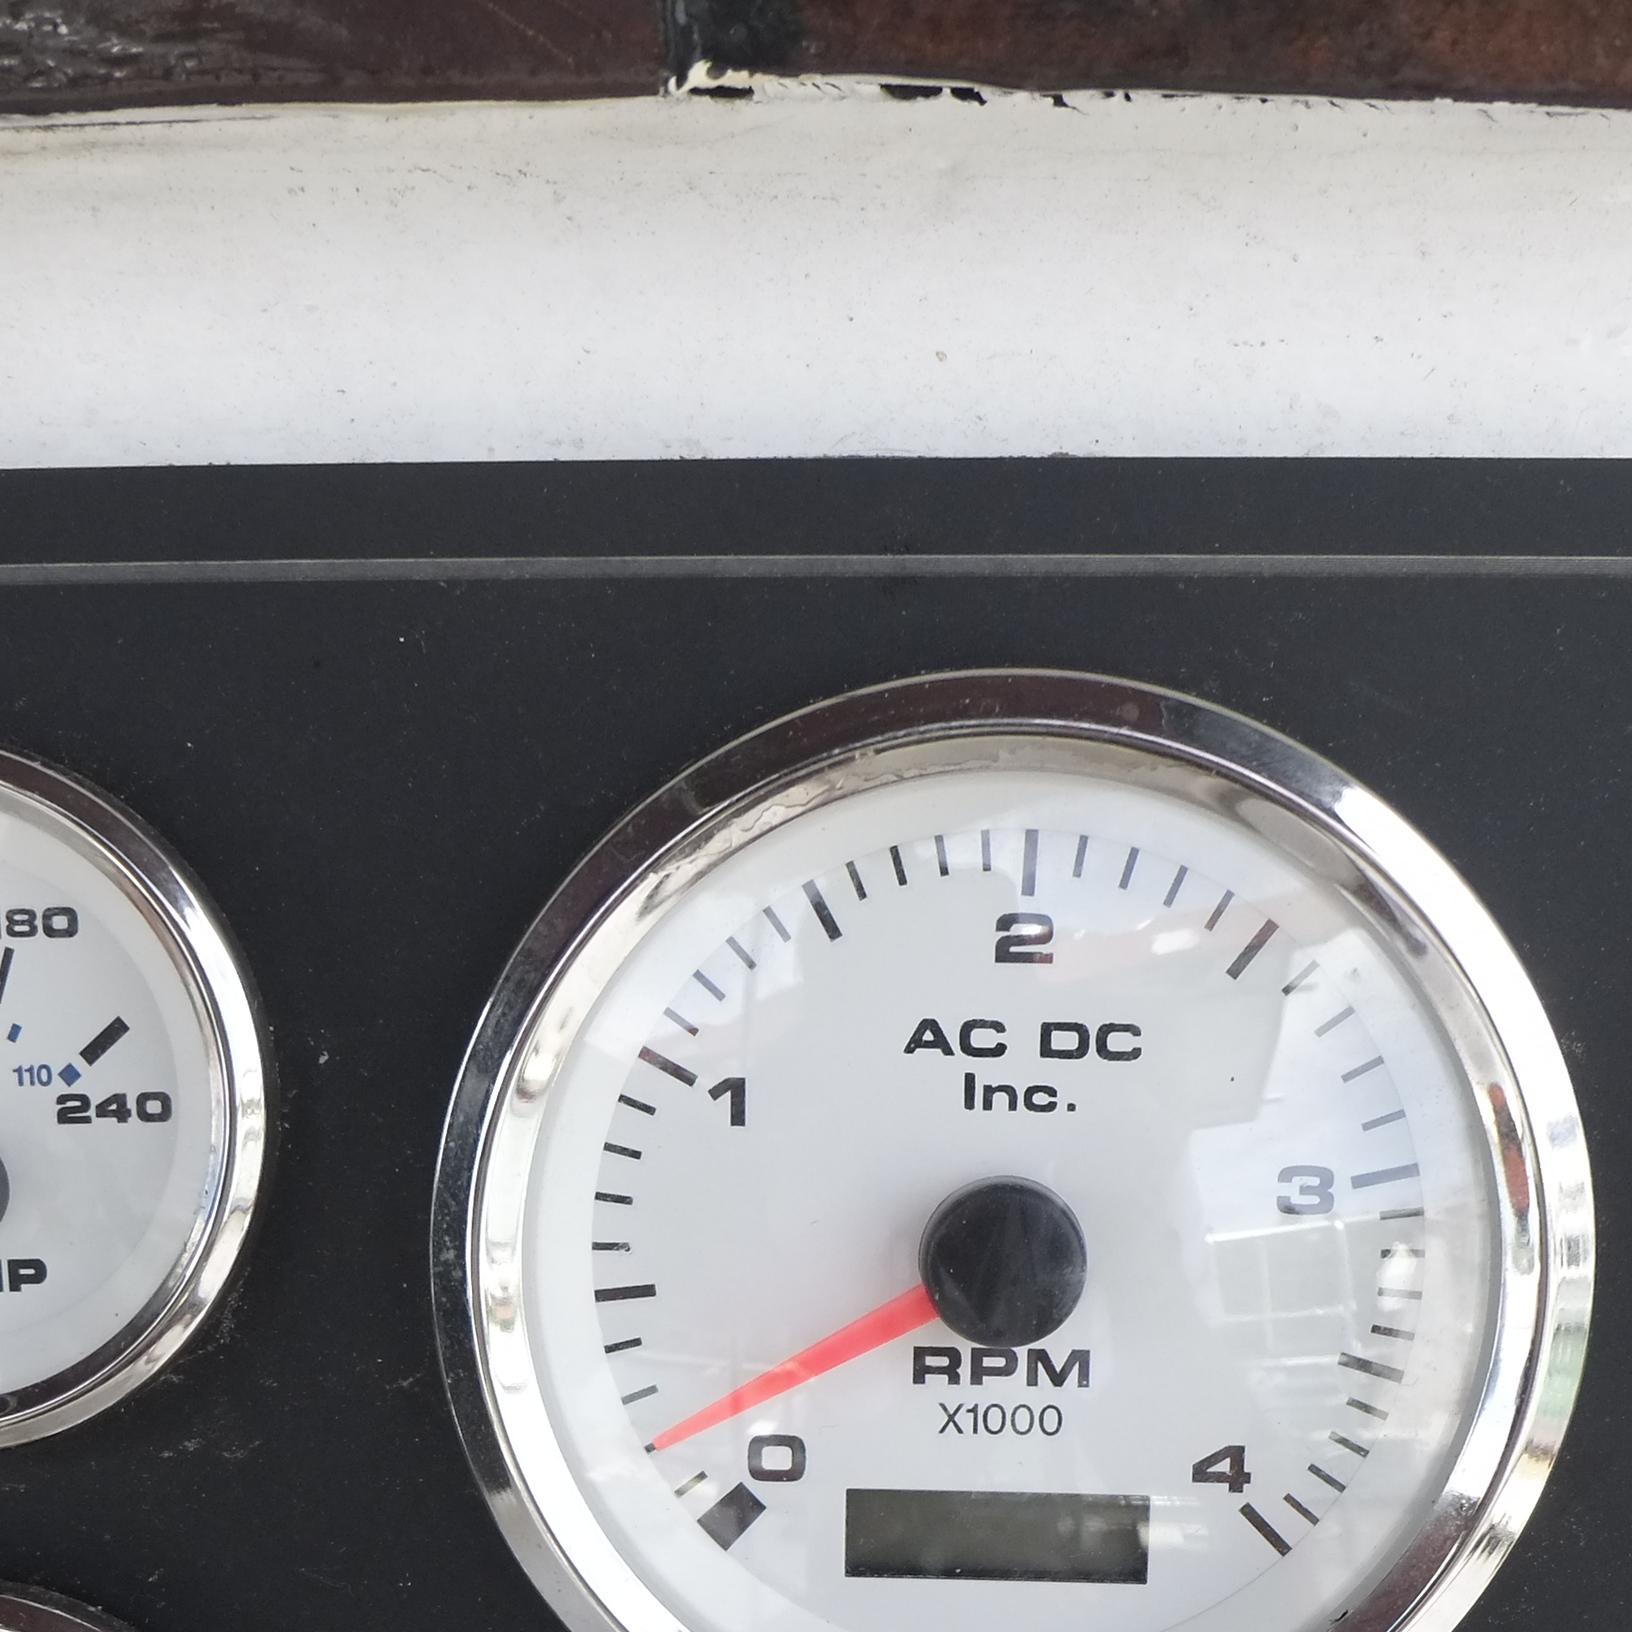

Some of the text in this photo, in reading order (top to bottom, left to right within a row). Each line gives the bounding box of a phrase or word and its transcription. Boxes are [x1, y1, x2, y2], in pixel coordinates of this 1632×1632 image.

[994, 914, 1053, 963] 2
[903, 1020, 1142, 1061] AC DC
[13, 1065, 52, 1087] 110
[963, 1073, 1076, 1112] Inc.
[56, 1092, 172, 1124] 240
[708, 1077, 746, 1126] 1
[1277, 1166, 1335, 1214] 3
[913, 1346, 1089, 1387] RPM
[939, 1403, 1062, 1435] X1000
[747, 1435, 805, 1482] 0
[1192, 1445, 1250, 1492] 4
